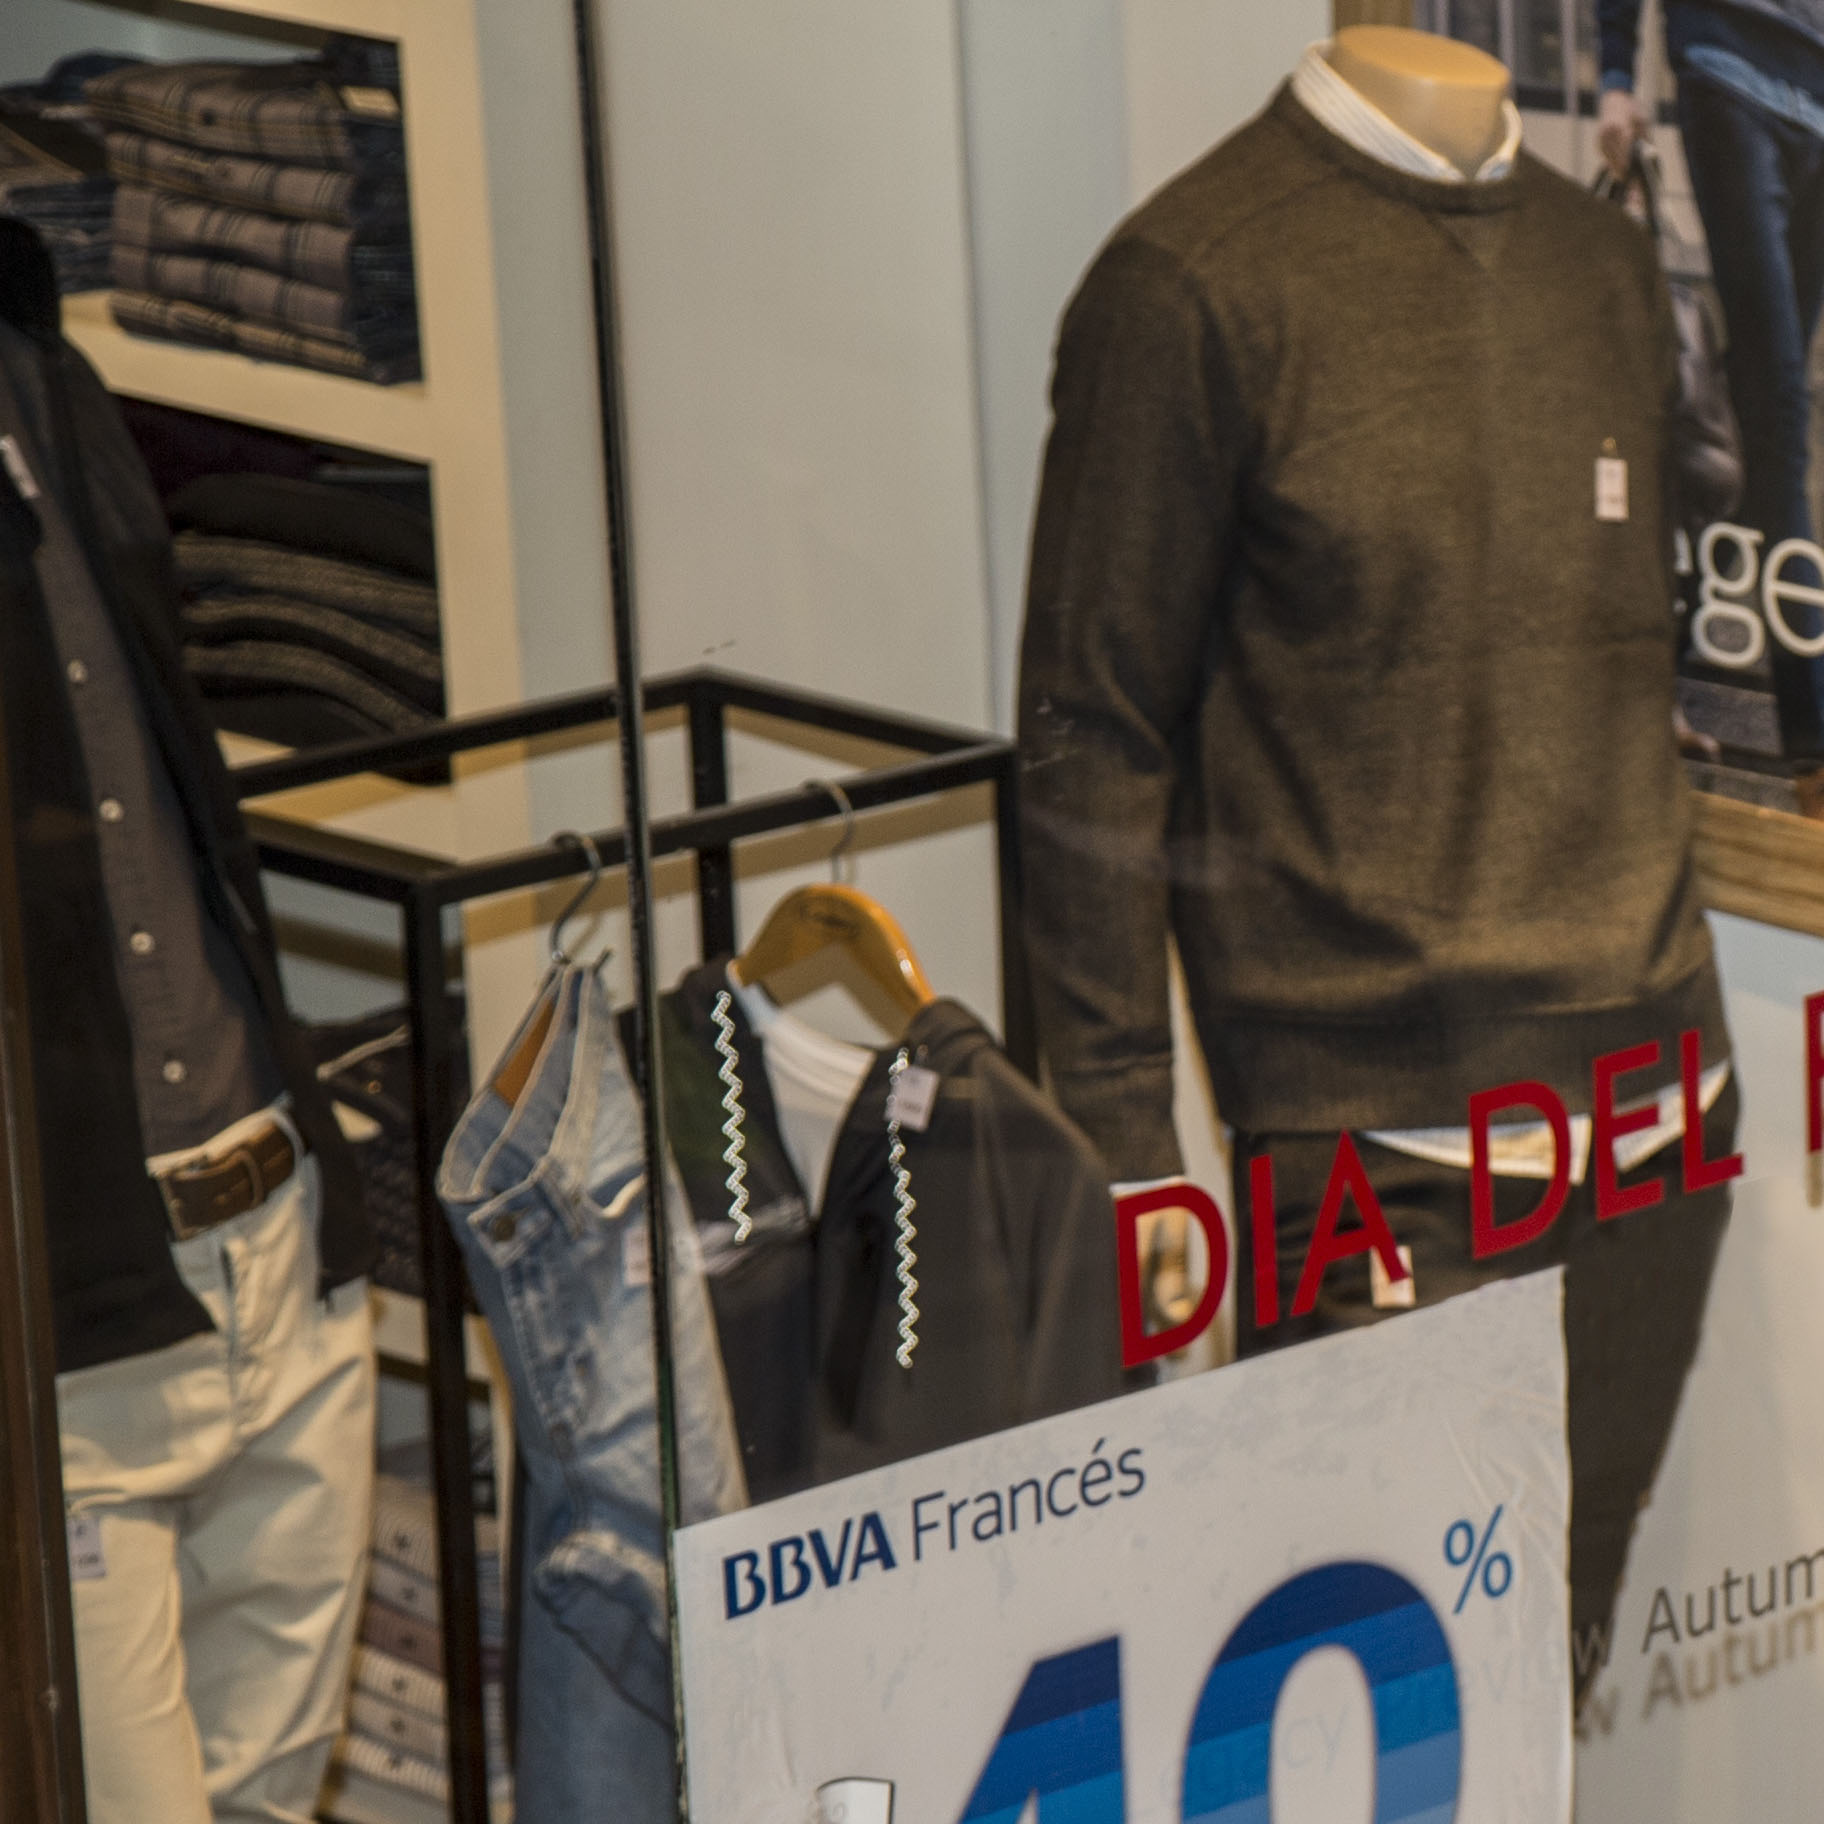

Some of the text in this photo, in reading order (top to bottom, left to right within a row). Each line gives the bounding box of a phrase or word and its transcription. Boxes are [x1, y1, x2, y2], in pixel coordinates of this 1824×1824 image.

[1113, 1130, 1411, 1369] DIA
[1468, 1029, 1743, 1257] DEL
[722, 1437, 1146, 1620] BBVA Francés
